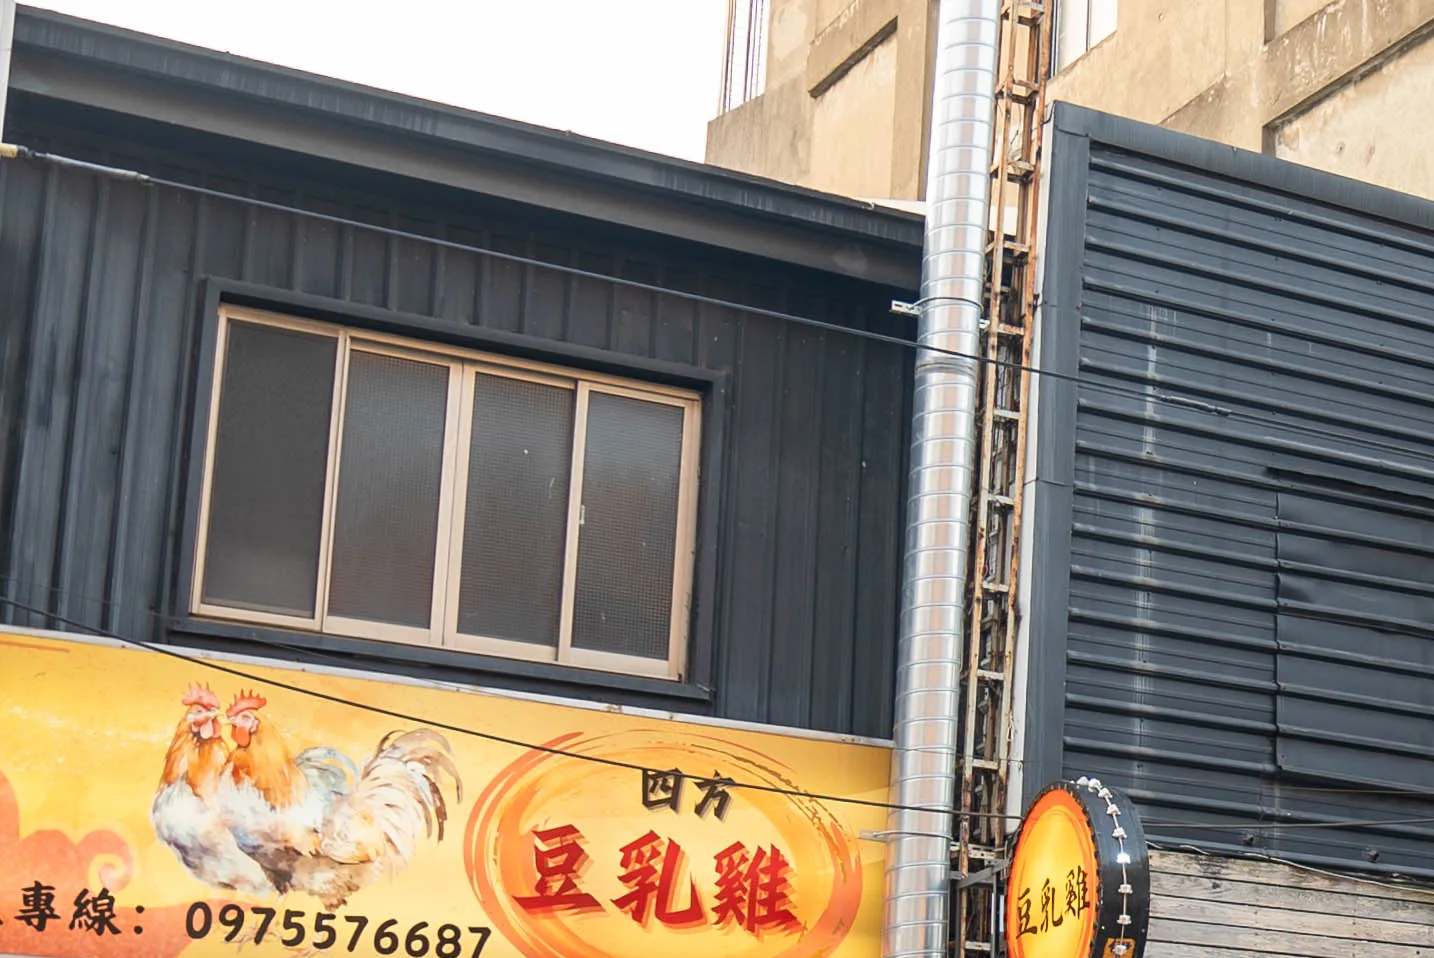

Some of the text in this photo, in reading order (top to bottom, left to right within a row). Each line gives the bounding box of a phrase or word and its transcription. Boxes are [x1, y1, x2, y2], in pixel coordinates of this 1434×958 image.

[641, 768, 737, 821] 四方
[511, 824, 805, 938] 豆乳雞
[1016, 865, 1091, 940] 豆乳雞
